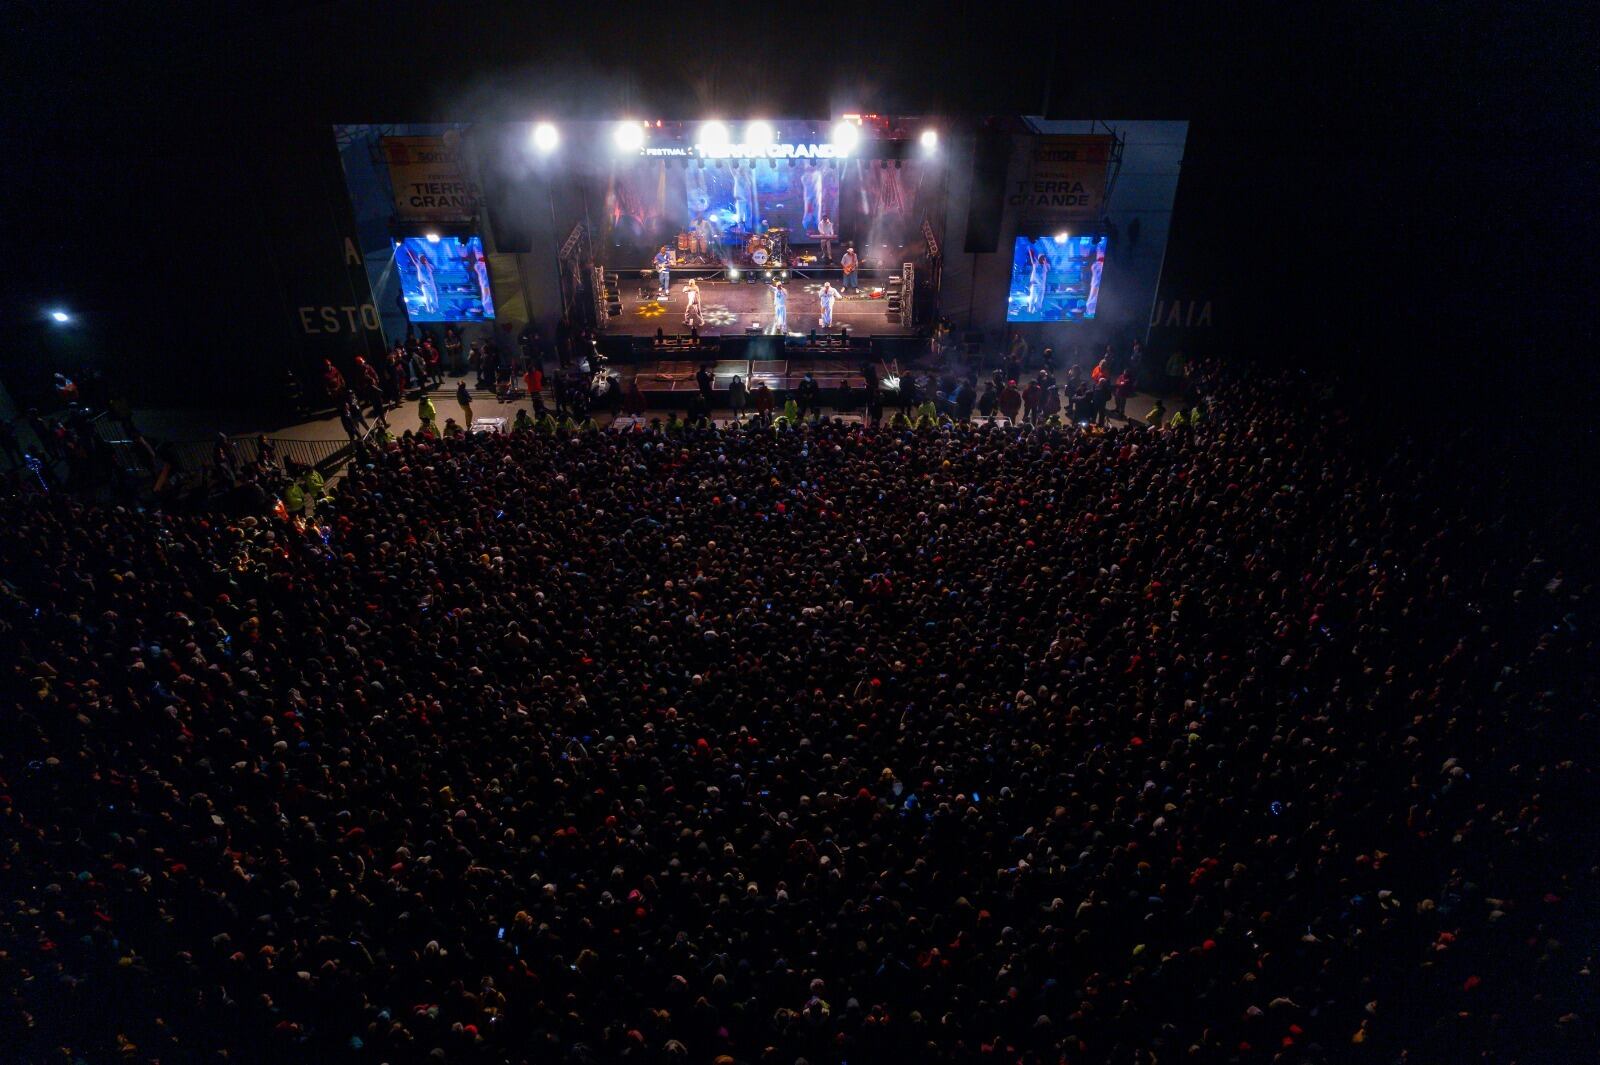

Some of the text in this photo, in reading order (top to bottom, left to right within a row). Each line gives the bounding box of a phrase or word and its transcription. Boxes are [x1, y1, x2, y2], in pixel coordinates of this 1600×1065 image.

[646, 147, 687, 156] FESTIVAL
[1015, 181, 1084, 193] TERRA
[298, 303, 380, 333] ESTO
